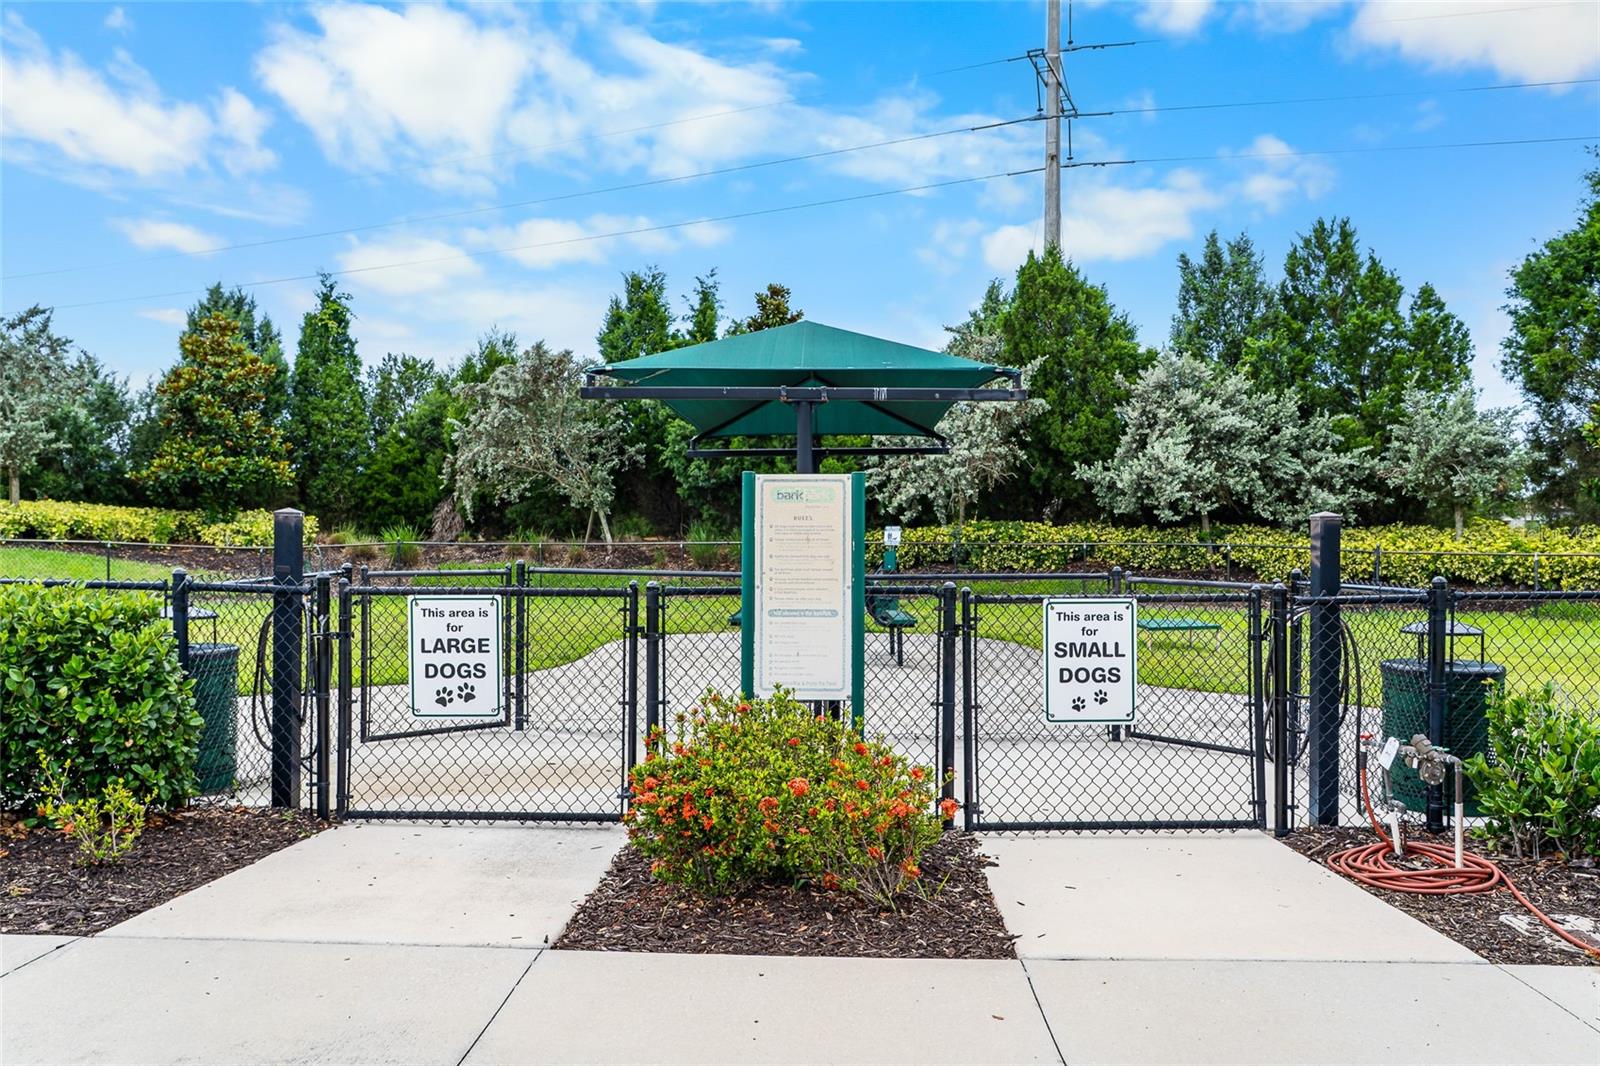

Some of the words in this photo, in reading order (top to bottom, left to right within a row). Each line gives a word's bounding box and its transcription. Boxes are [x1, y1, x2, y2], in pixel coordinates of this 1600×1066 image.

[421, 608, 445, 617] This
[479, 608, 488, 617] is
[1056, 612, 1080, 621] This
[1114, 611, 1123, 621] is
[447, 623, 463, 632] for
[1082, 627, 1098, 636] for
[421, 638, 490, 653] LARGE
[1054, 642, 1125, 658] SMALL
[425, 663, 486, 679] DOGS
[1060, 667, 1121, 683] DOGS
